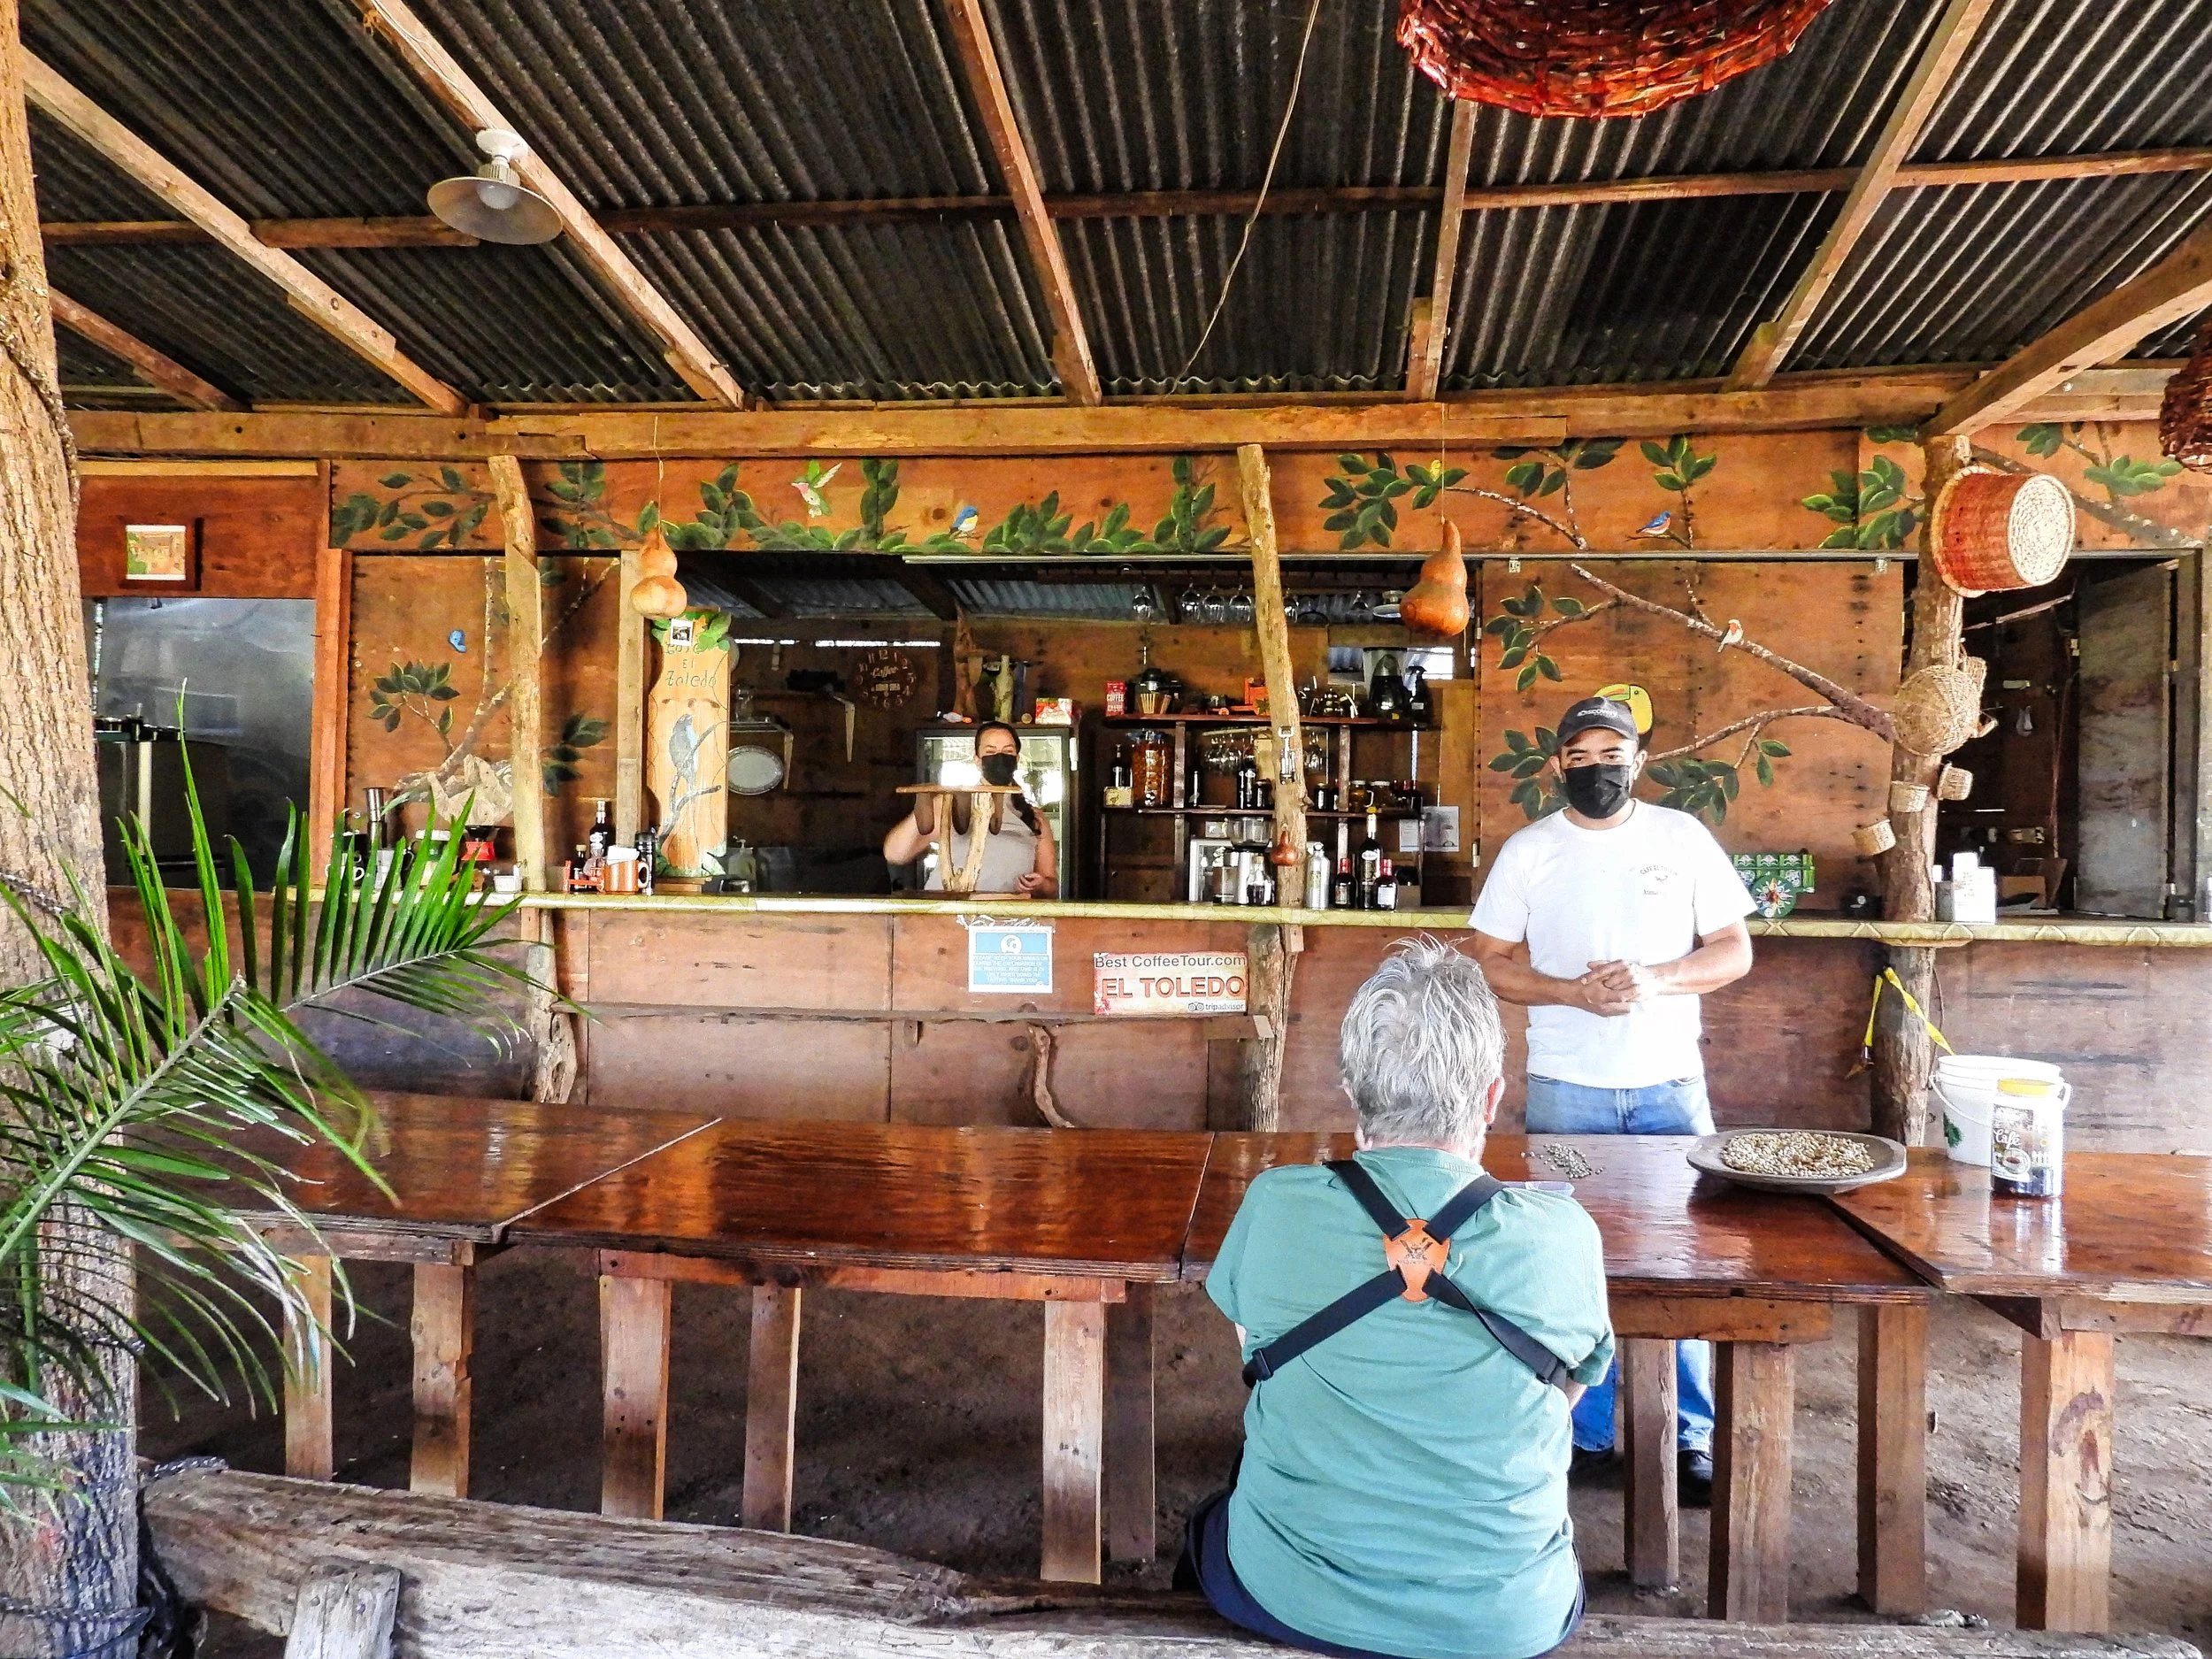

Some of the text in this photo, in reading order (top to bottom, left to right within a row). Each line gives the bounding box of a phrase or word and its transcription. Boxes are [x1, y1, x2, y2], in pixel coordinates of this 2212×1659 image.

[1094, 956, 1127, 968] Best
[1102, 976, 1245, 998] EL TOLEDO
[1205, 1002, 1244, 1011] tripadvisor
